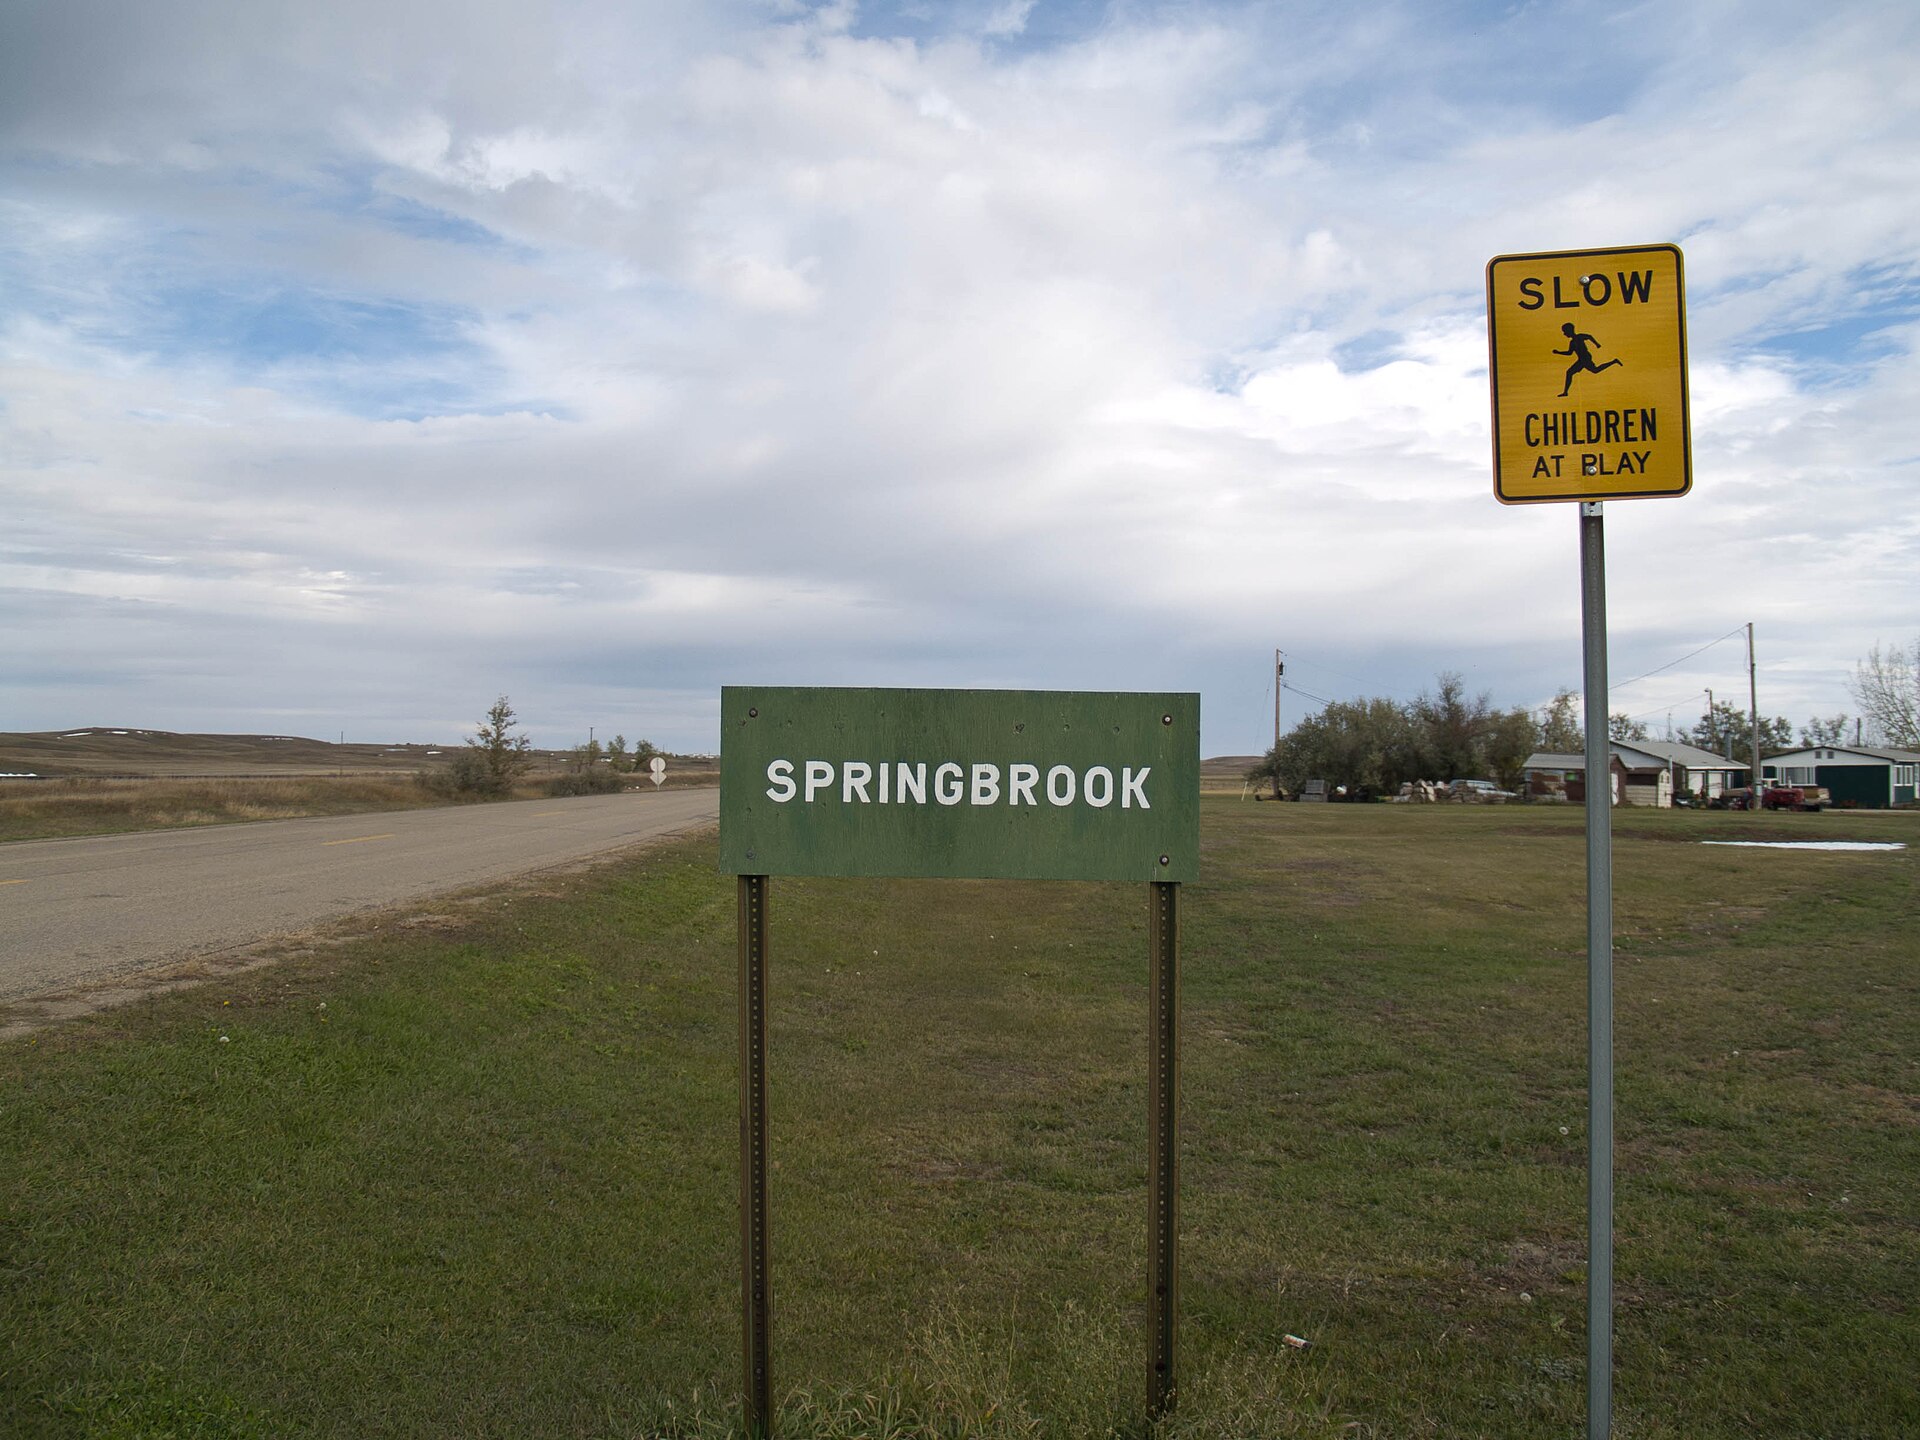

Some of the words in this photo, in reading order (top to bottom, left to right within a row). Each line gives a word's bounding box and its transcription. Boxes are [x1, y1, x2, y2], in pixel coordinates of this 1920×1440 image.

[1518, 270, 1653, 310] SLOW
[1525, 408, 1657, 447] CHILDREN
[1532, 455, 1565, 478] AT
[1581, 451, 1652, 476] PLAY
[765, 759, 1151, 809] SPRINGBROOK
